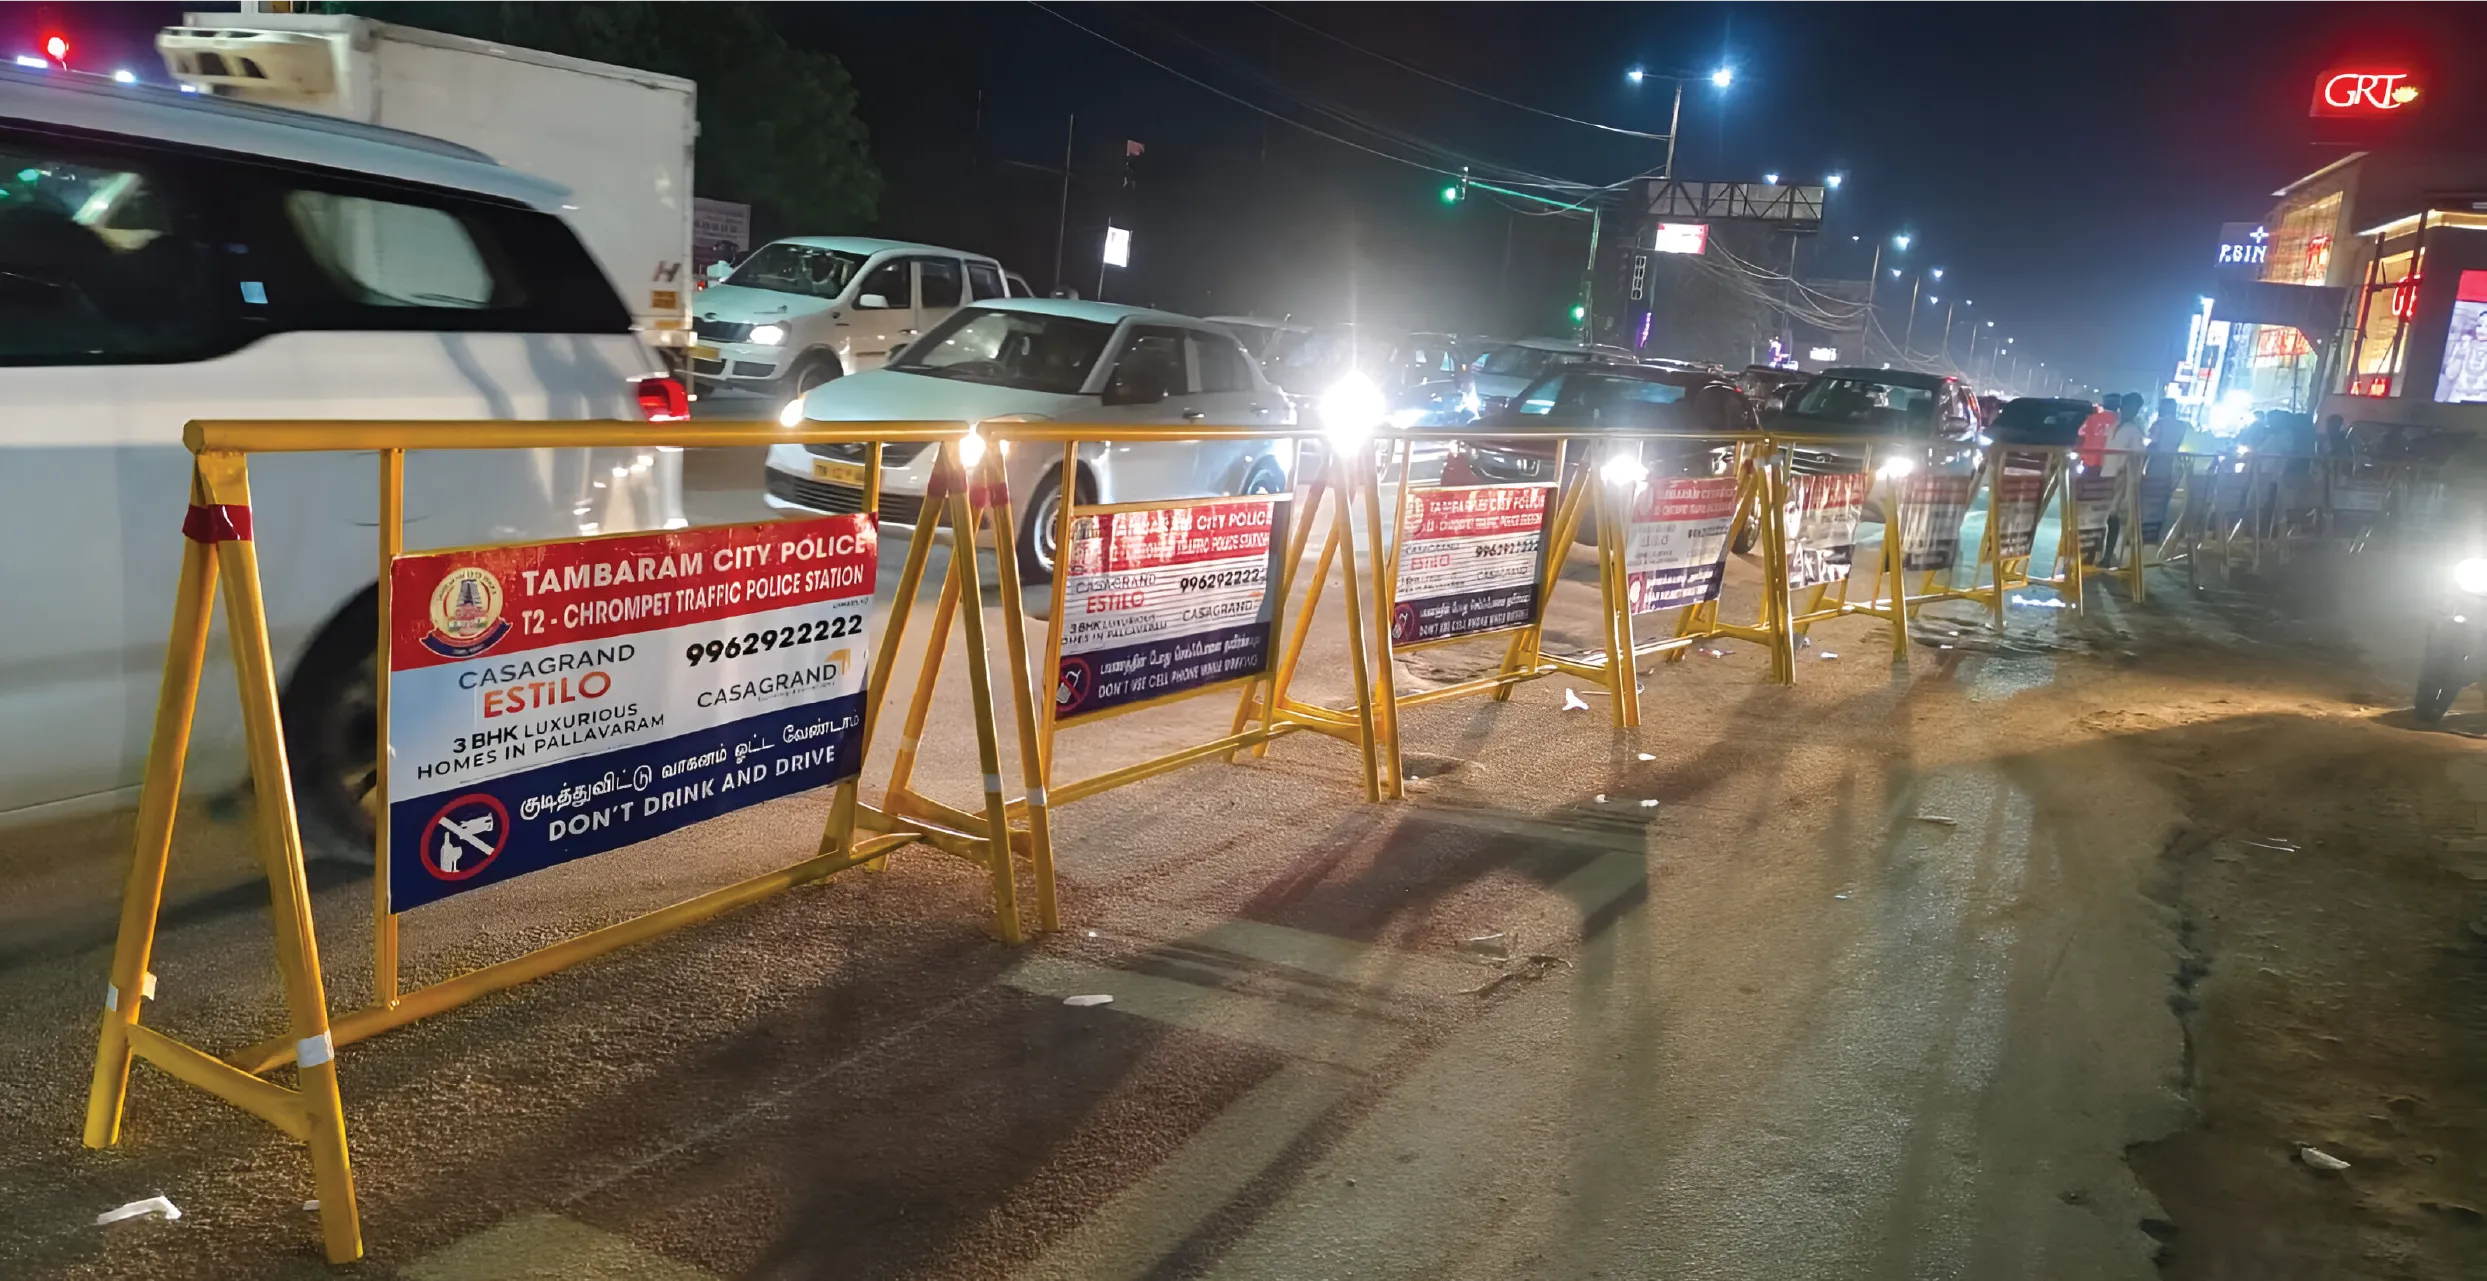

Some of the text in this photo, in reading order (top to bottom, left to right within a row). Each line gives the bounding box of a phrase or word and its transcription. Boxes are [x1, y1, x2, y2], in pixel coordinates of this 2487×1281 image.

[2325, 73, 2407, 109] GRT
[522, 552, 703, 596] TAMBARAM
[713, 543, 771, 572] CITY
[781, 534, 866, 563] POLICE
[1076, 574, 1156, 594] CASAGRAND
[521, 609, 545, 635] T2
[563, 591, 671, 629] CHROMPET
[675, 581, 741, 614] TRAFFIC
[746, 572, 801, 601] POLICE
[805, 563, 864, 593] STATION
[1182, 600, 1253, 621] CASAGRAND
[686, 614, 863, 667] 9962922222
[458, 644, 635, 690] CASAGRAND
[697, 664, 837, 708] CASAGRAND
[417, 713, 664, 780] HOMES IN PALLAVARAM
[453, 703, 638, 754] 3 BHK LUXURIOUS
[520, 709, 860, 821] குடித்துவிட்டு வாகனம் ஓட்ட வேண்டாம்
[549, 745, 836, 842] DON'T DRINK AND DRIVE
